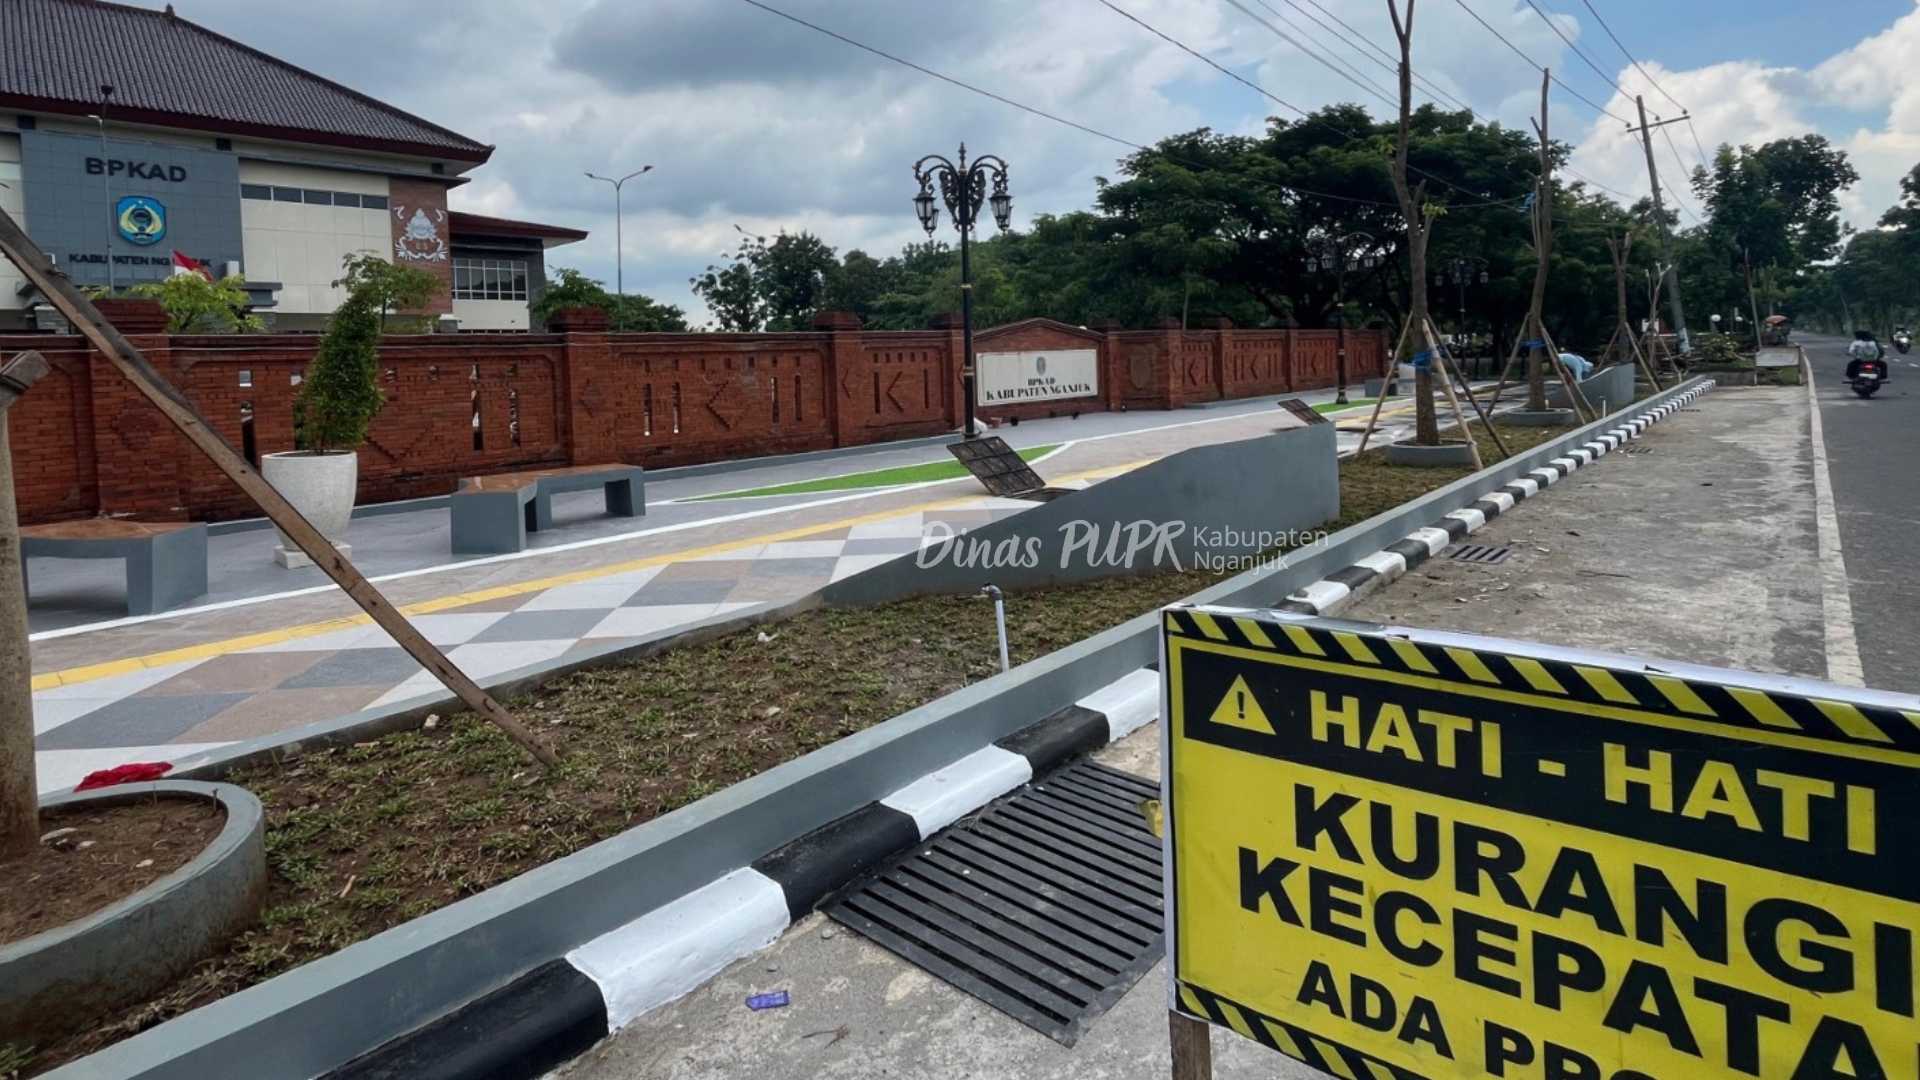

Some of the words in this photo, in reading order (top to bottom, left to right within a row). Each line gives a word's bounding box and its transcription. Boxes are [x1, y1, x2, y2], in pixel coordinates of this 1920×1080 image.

[85, 157, 187, 182] BPKAD
[69, 253, 149, 266] KABUPATEN
[986, 386, 1048, 401] KABUPATEN
[1050, 383, 1091, 394] NGANJUK
[1027, 377, 1056, 386] BPKAD
[1310, 691, 1502, 778] HATI
[1603, 743, 1876, 855] HATI
[1294, 783, 1915, 1019] KURANGI
[1239, 846, 1920, 1080] KECEPATA
[1296, 960, 1455, 1061] ADA
[1484, 1020, 1660, 1080] PR
